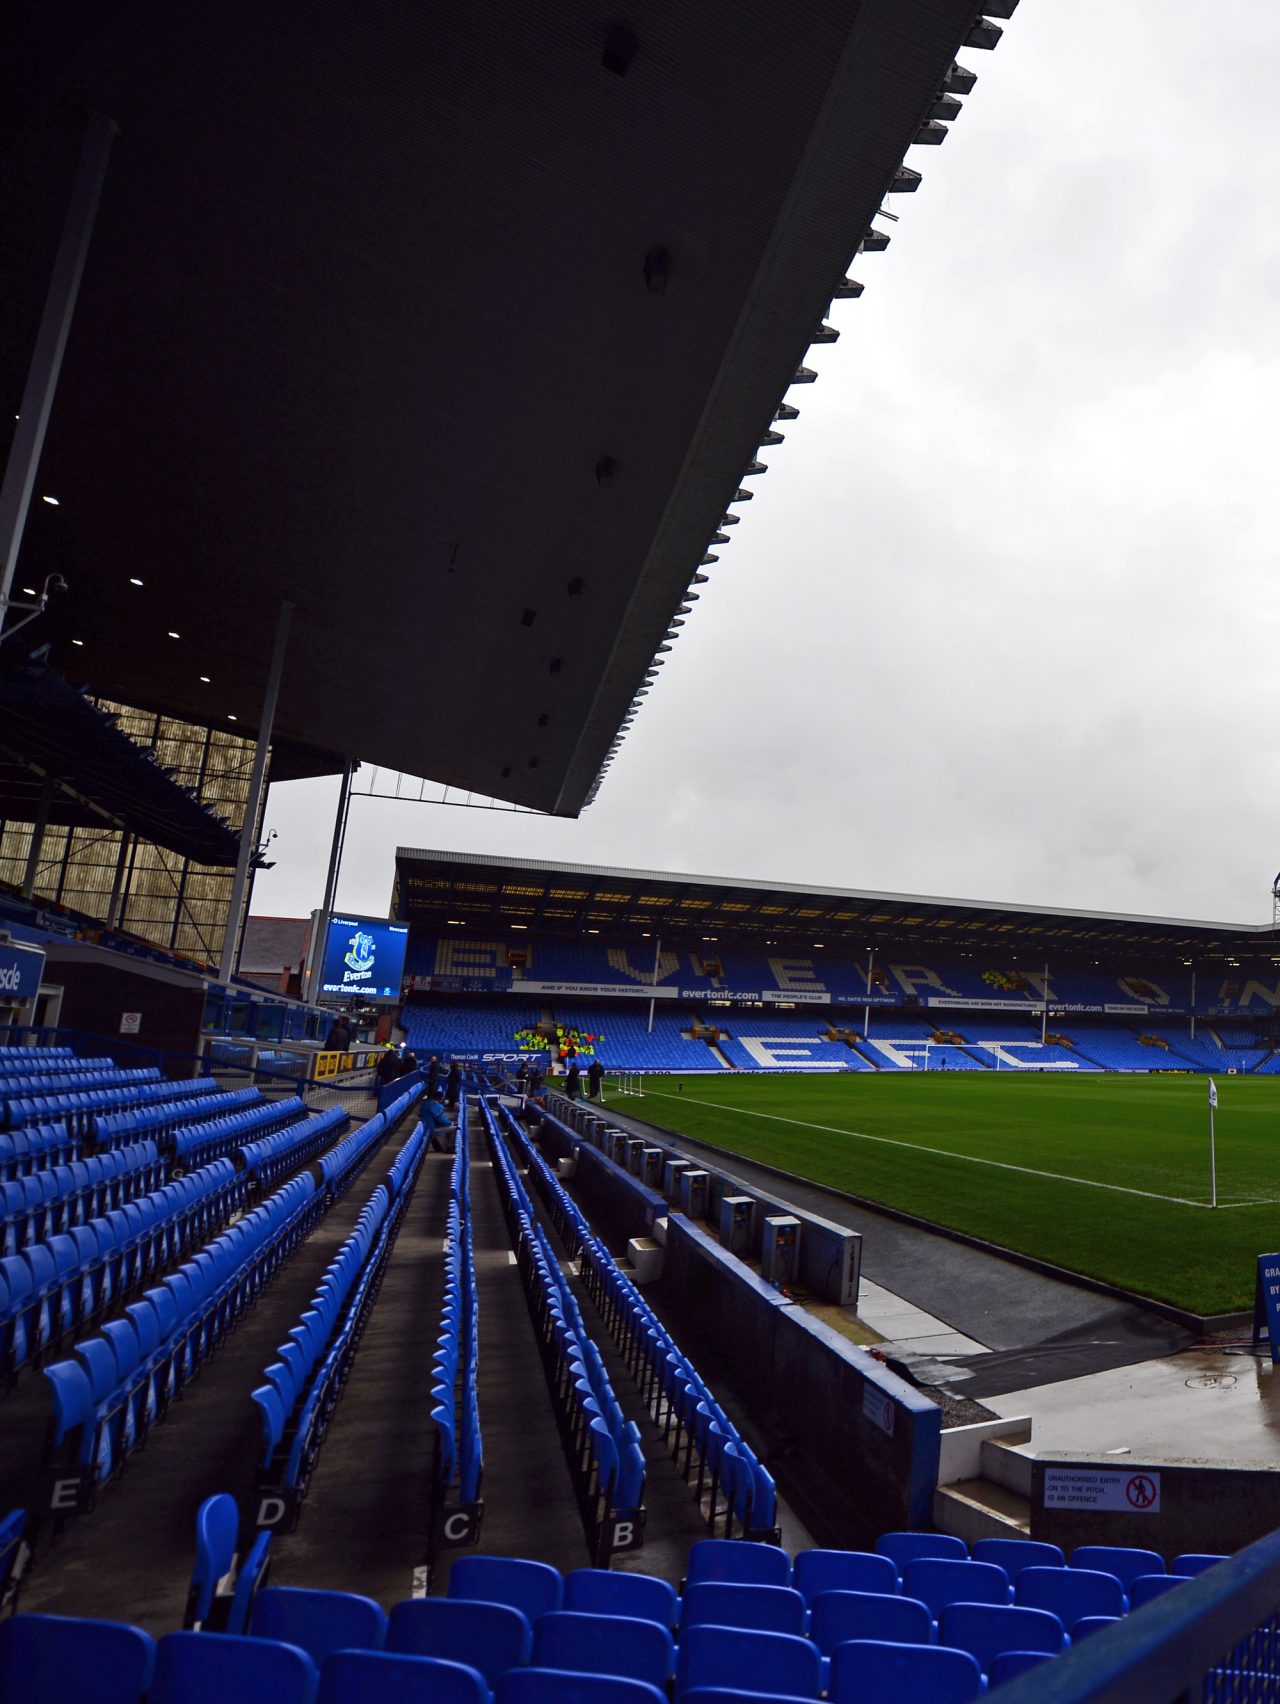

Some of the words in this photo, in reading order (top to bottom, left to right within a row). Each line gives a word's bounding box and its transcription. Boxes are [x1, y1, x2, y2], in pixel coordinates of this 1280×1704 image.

[343, 970, 372, 982] Everton
[323, 983, 377, 994] evertonfc.com
[682, 989, 759, 1001] evertonfc.com
[1048, 1003, 1103, 1012] evertonfc.com
[481, 1053, 541, 1061] SPORT
[171, 1168, 184, 1180] G
[1270, 1285, 1280, 1295] BY
[1048, 1474, 1097, 1483] UNAUTHORISED
[1099, 1477, 1120, 1485] ENTRY
[50, 1478, 81, 1510] E
[256, 1498, 286, 1525] D
[444, 1512, 470, 1540] C
[613, 1522, 634, 1547] B
